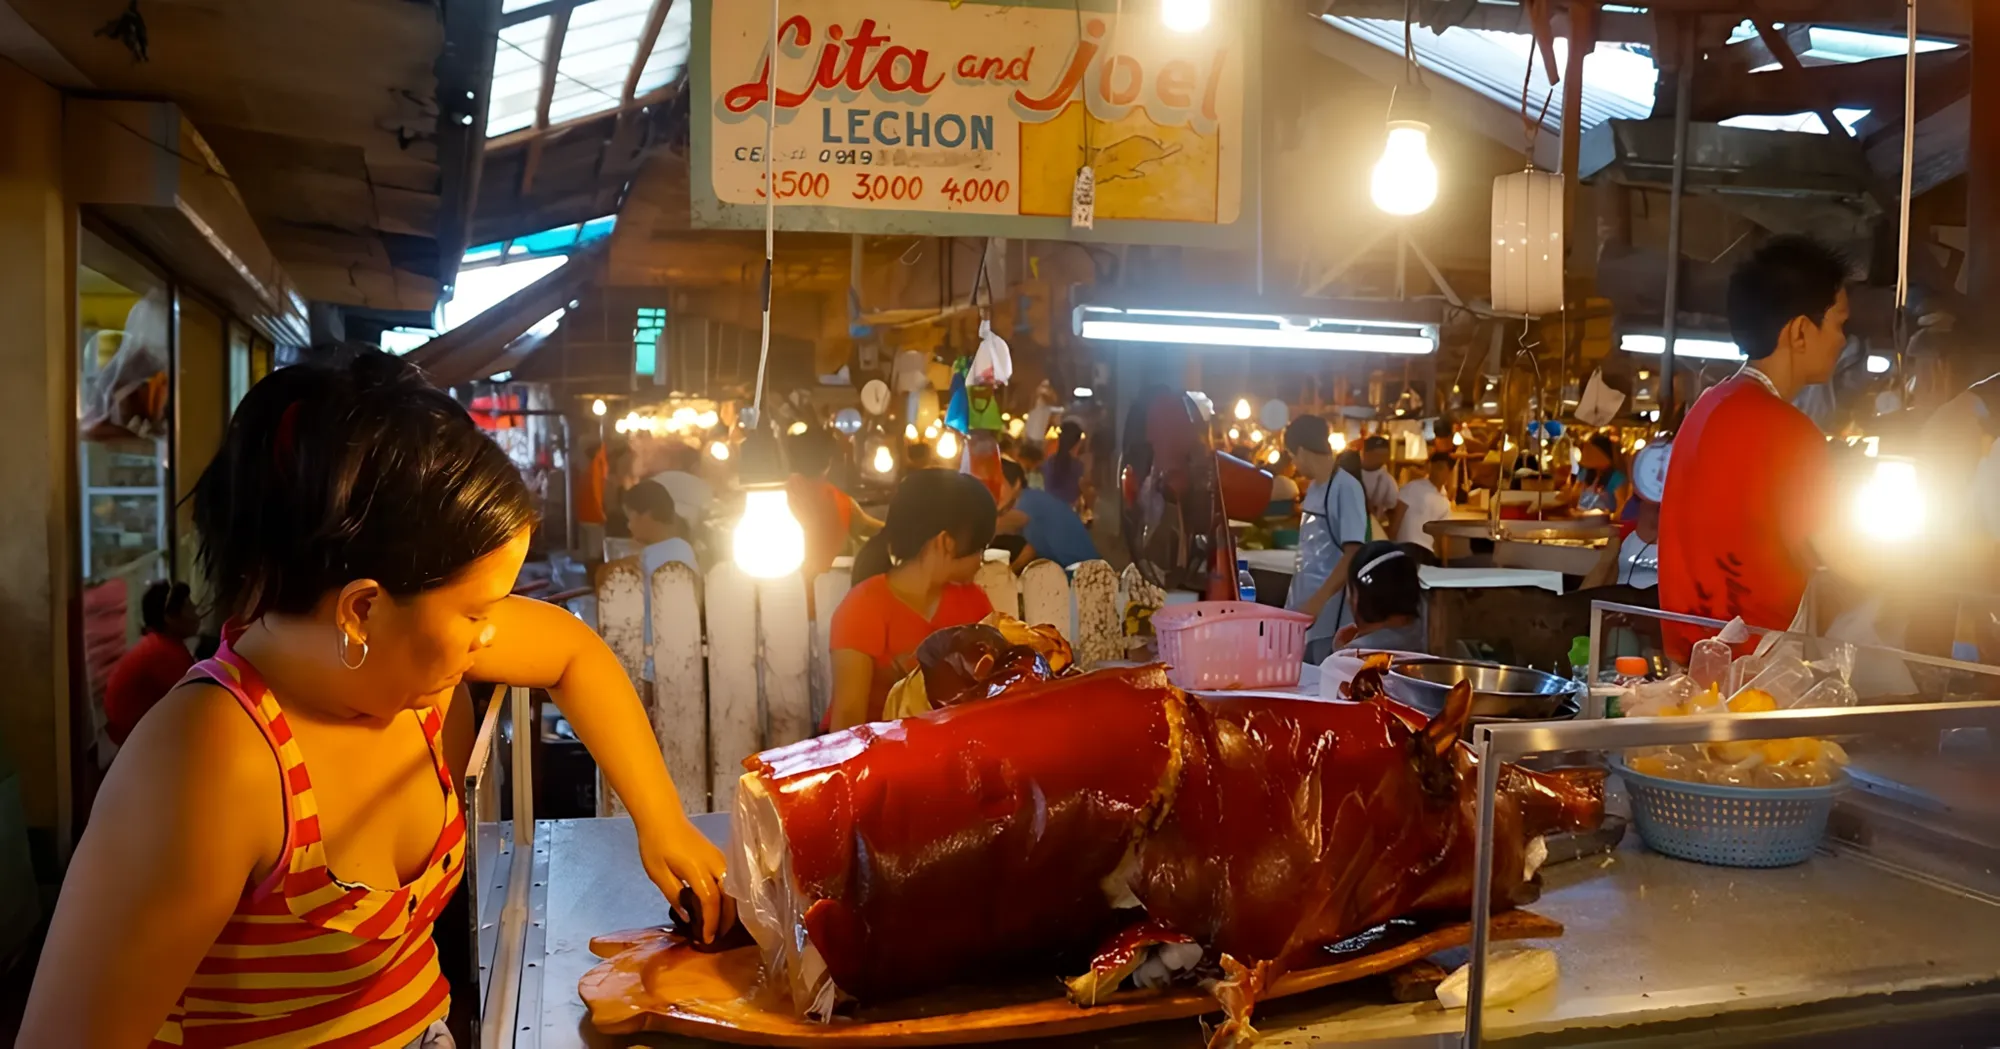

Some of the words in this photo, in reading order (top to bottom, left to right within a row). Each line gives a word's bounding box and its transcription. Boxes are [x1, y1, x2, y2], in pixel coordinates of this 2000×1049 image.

[723, 14, 946, 113] Lita
[956, 46, 1036, 82] and
[822, 107, 994, 150] LECHON
[852, 172, 923, 202] 3,000
[941, 177, 1010, 204] 4,000
